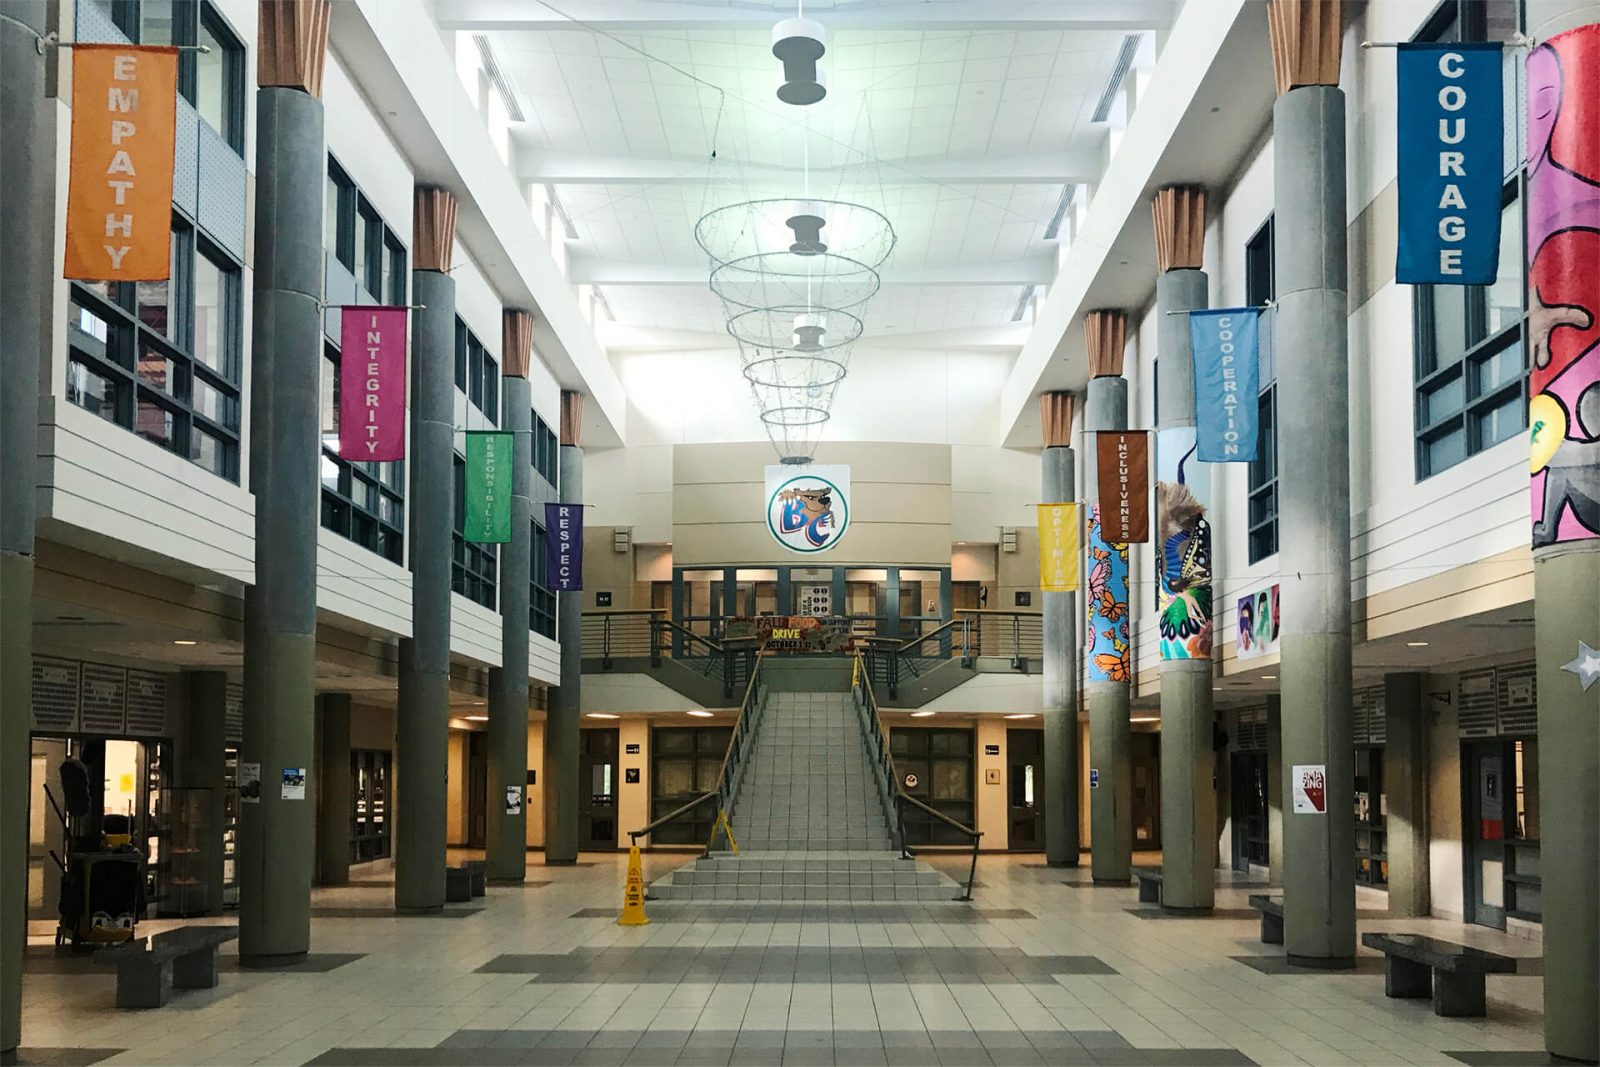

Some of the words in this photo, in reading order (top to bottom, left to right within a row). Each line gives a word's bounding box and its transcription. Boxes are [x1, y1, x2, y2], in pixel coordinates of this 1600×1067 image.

[103, 54, 139, 270] EMPATHY
[1438, 51, 1467, 275] COURAGE
[365, 315, 381, 454] INTEGRITY
[1218, 317, 1239, 455] COOPERATION
[484, 436, 495, 538] RESPONSIBILITY
[1118, 435, 1130, 539] INCLUSIVENESS
[559, 506, 570, 589] RESPECT
[1052, 508, 1065, 588] OPTIMISM
[772, 628, 801, 639] DRIVE
[1302, 779, 1323, 789] ZING
